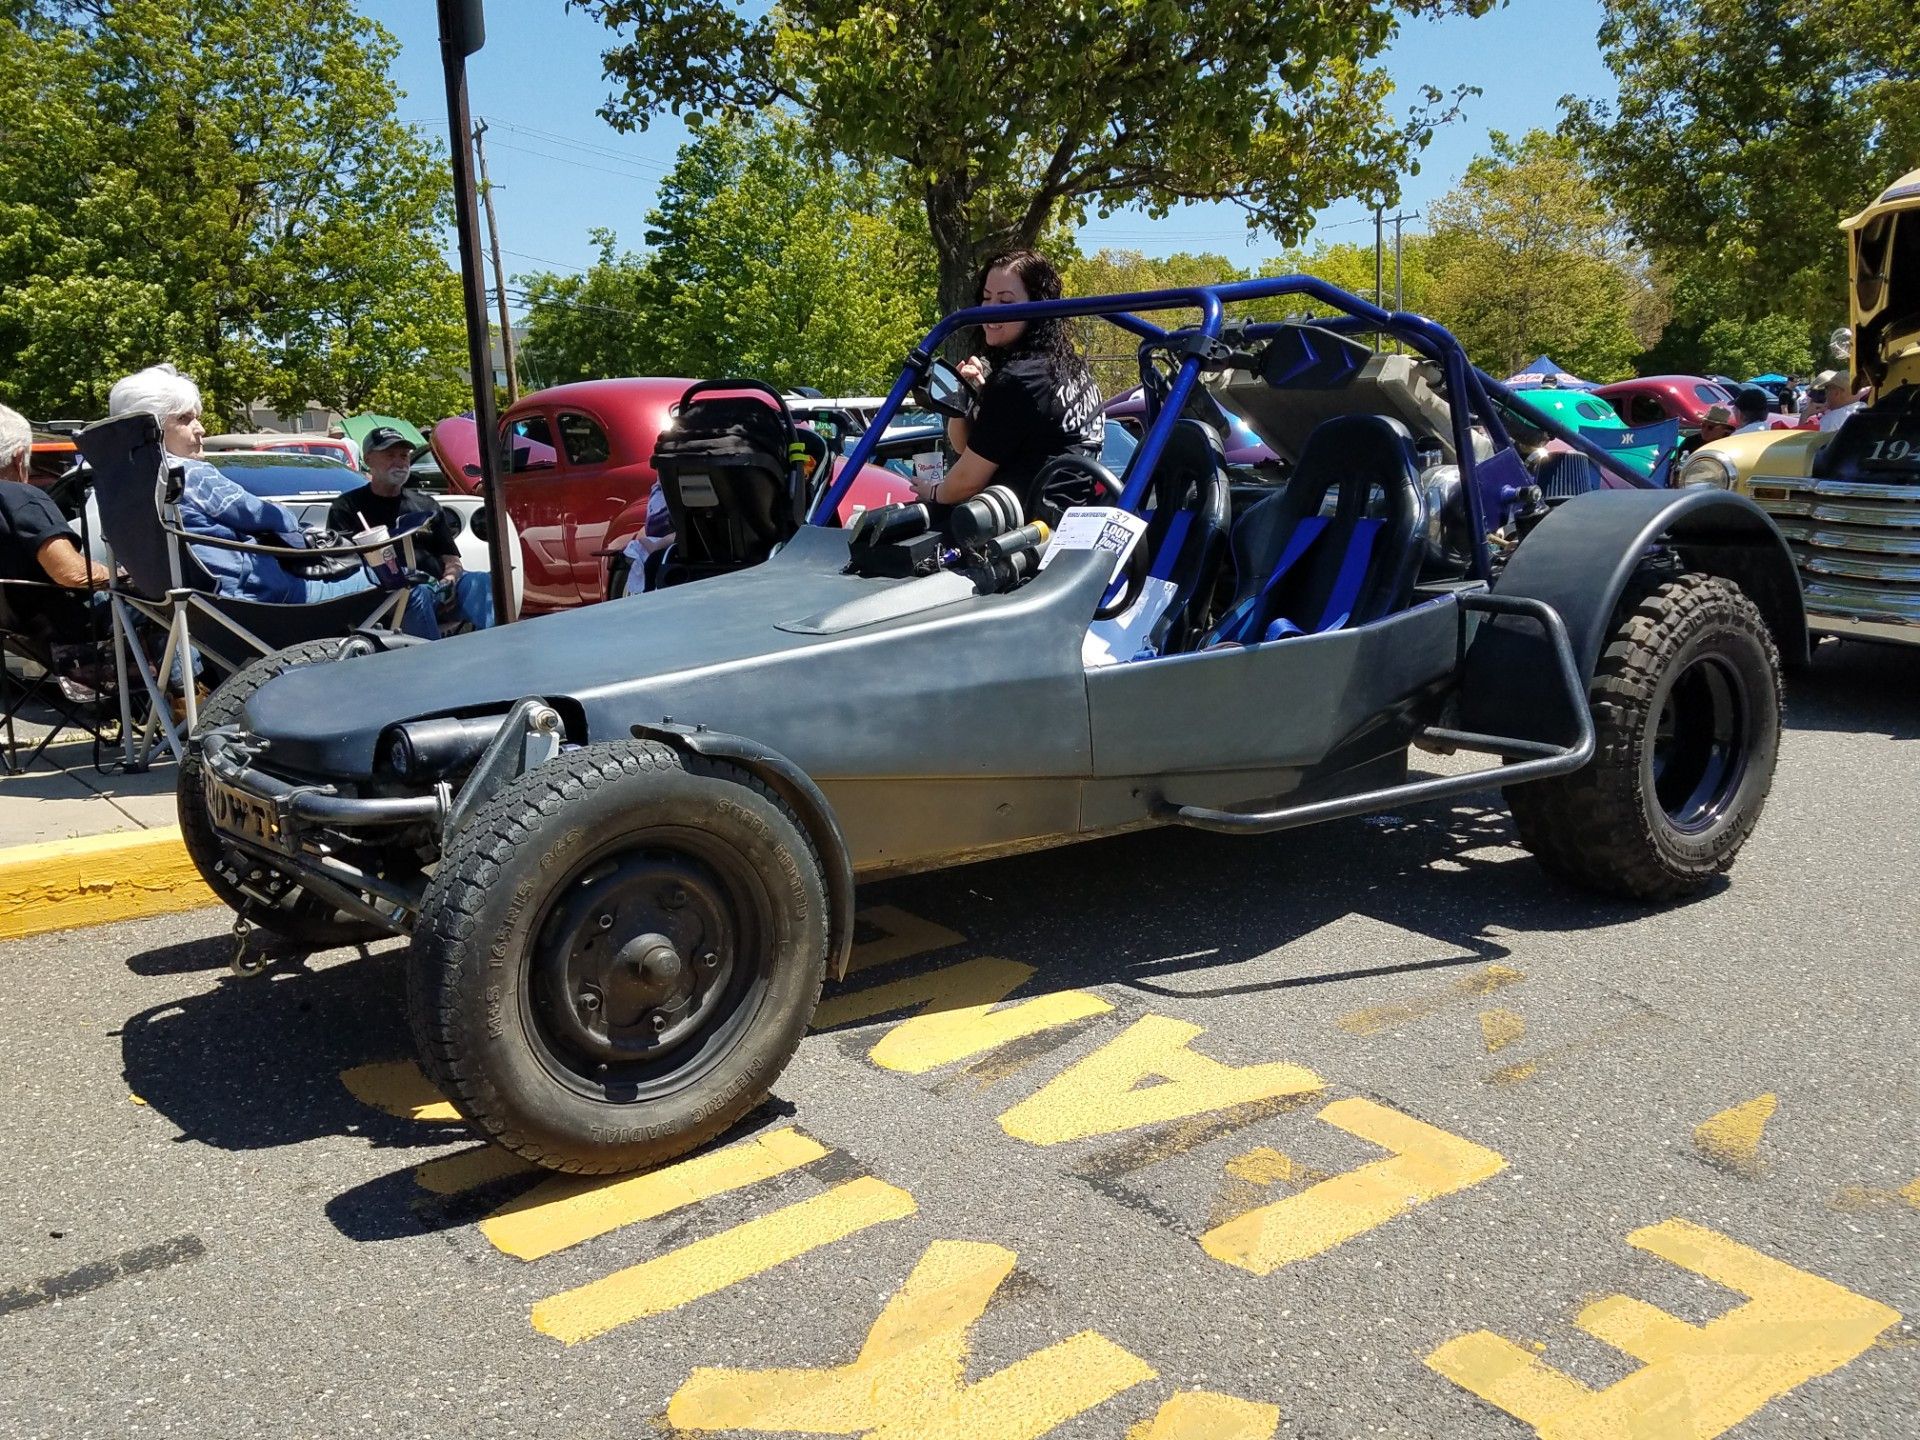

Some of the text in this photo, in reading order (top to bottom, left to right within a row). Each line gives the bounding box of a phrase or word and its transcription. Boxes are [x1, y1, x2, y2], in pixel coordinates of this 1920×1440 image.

[1103, 522, 1132, 543] LOOK
[590, 1058, 766, 1146] METRIC RADIAL
